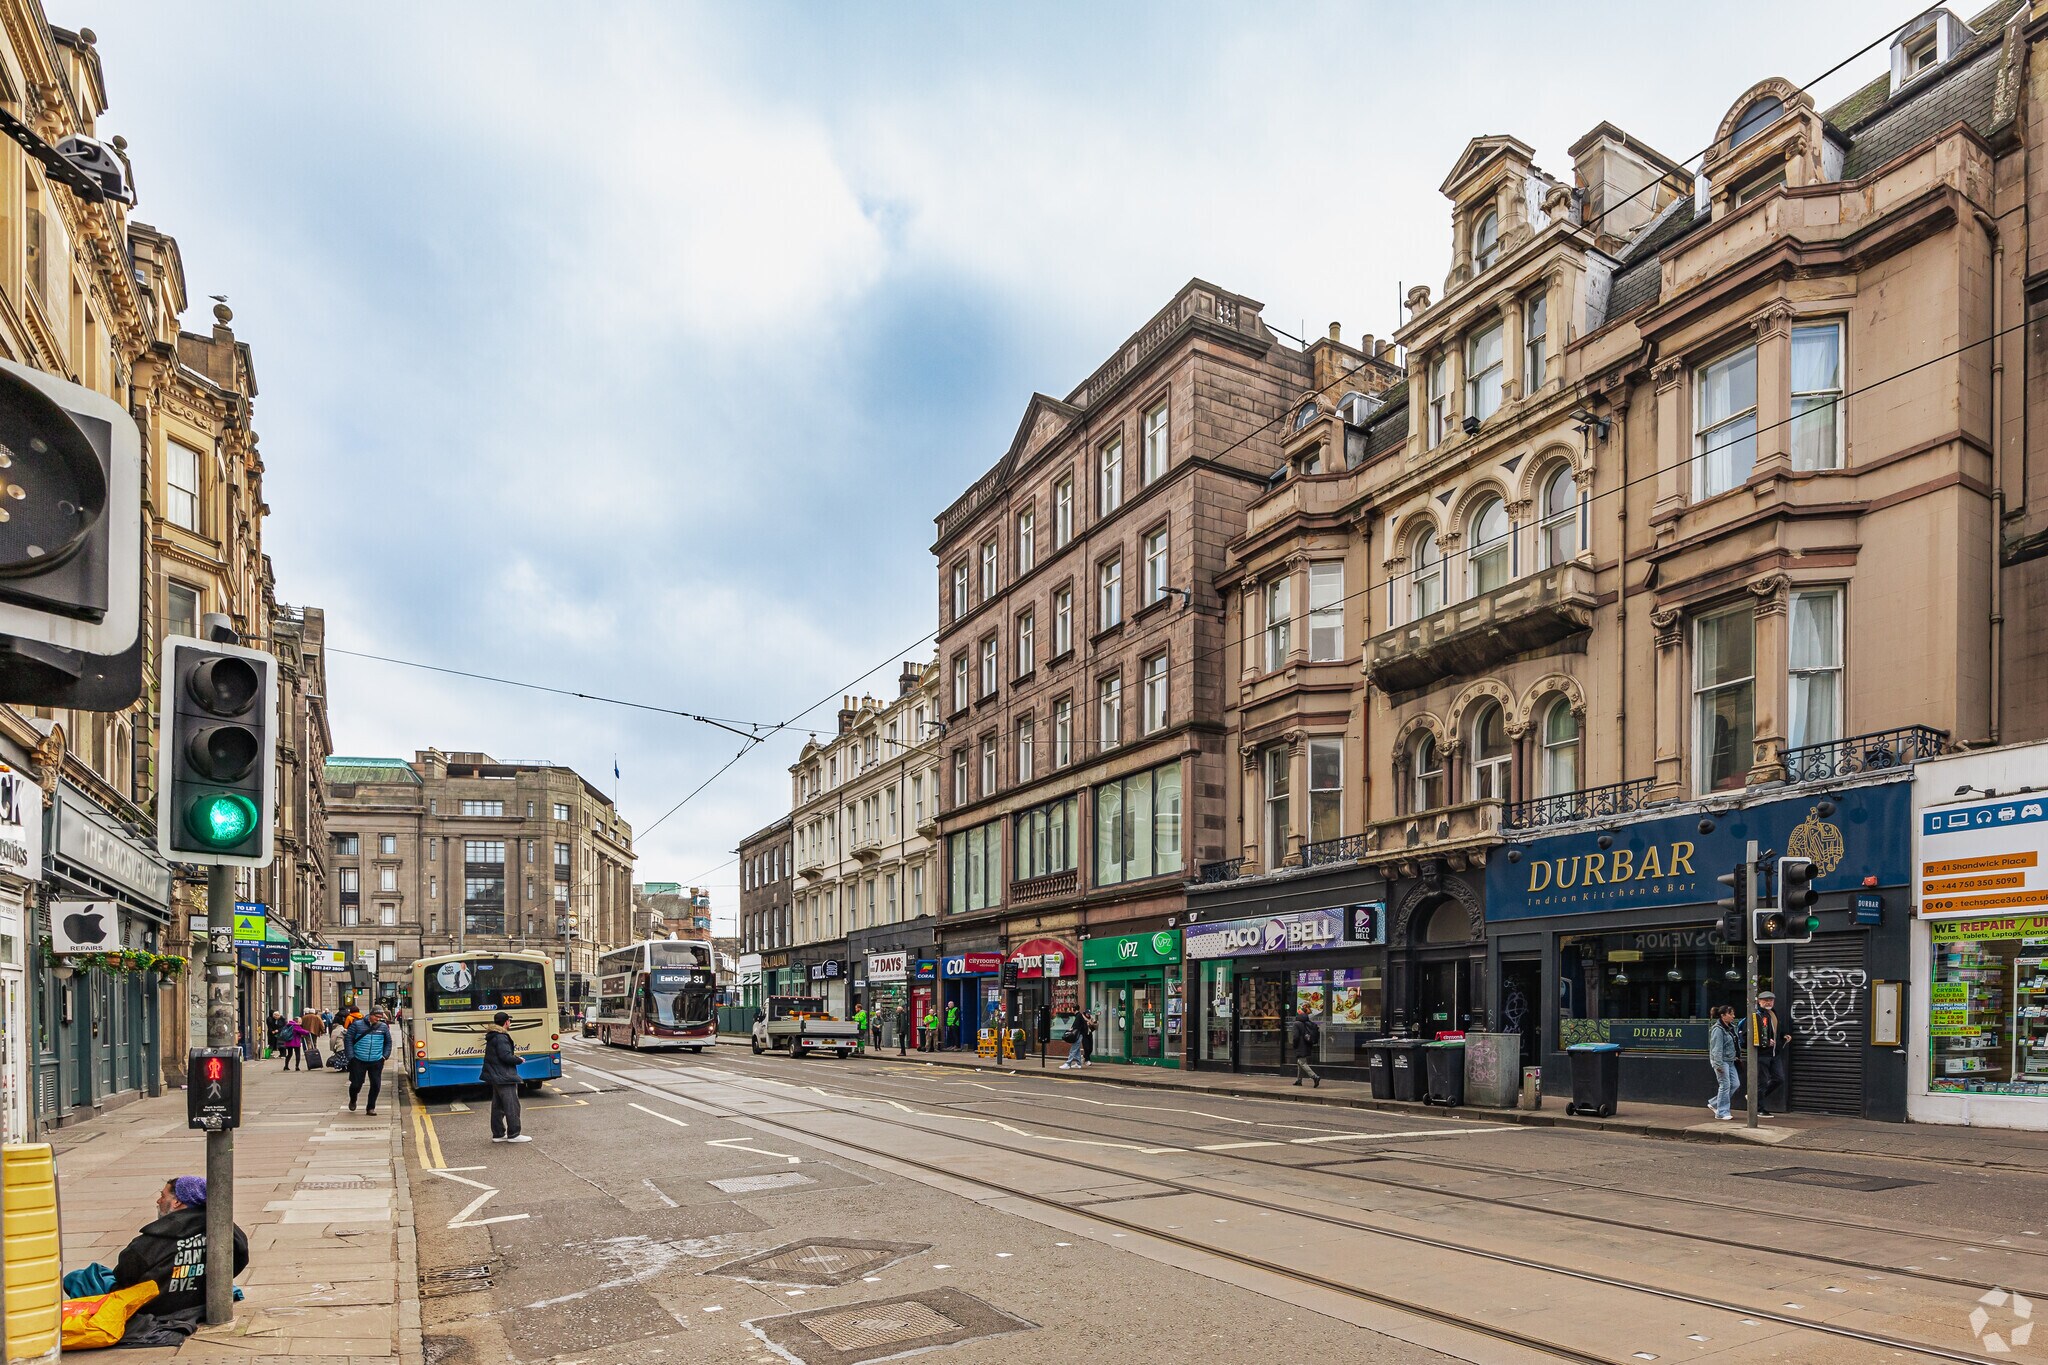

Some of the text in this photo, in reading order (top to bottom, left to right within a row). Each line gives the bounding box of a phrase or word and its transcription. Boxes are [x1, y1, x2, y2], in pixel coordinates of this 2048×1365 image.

[83, 824, 157, 892] THE GROSVENOR
[1952, 860, 1999, 870] Shandwick
[2002, 858, 2027, 866] Place
[1527, 842, 1695, 892] DURBAR
[1977, 879, 1993, 887] 350
[1996, 877, 2018, 885] 5090
[1528, 883, 1696, 906] Indian Kitchen & Bar
[1219, 918, 1334, 948] TACO BELL
[1934, 923, 1957, 934] WE
[1960, 920, 2016, 932] REPAIR
[1991, 930, 2023, 938] Laptops,
[1120, 941, 1138, 957] VPZ
[1157, 938, 1171, 947] VPZ
[770, 953, 787, 967] ITALIAN
[875, 960, 880, 972] 7
[881, 957, 902, 972] DAYS
[693, 975, 704, 984] 31
[503, 996, 521, 1004] X38
[1633, 1028, 1682, 1037] DURBAR
[169, 1277, 198, 1292] BYE.
